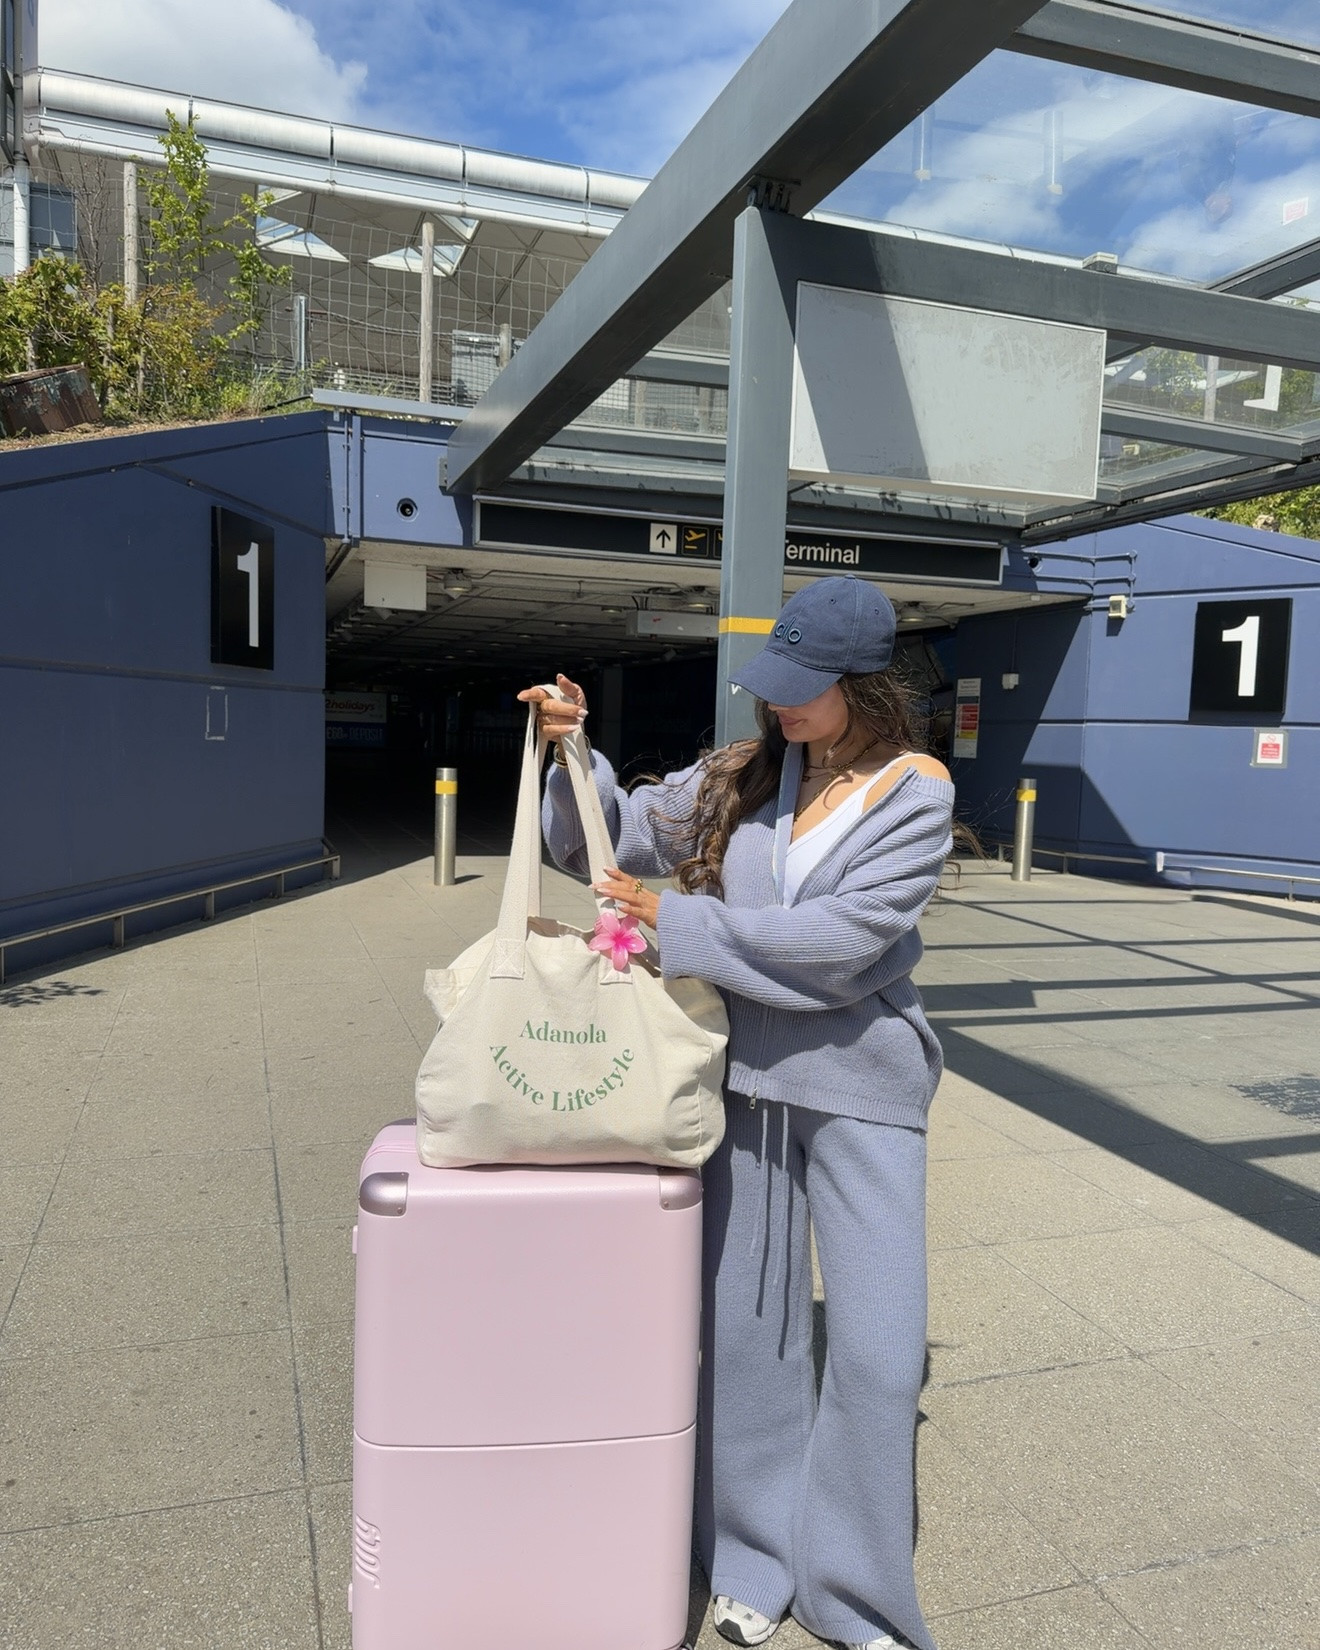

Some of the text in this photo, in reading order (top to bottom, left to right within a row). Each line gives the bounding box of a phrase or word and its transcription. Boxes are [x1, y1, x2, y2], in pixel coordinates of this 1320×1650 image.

[785, 540, 860, 564] erminal
[237, 541, 259, 648] 1
[1222, 616, 1260, 697] 1
[519, 1019, 607, 1045] Adanola
[489, 1045, 635, 1112] Active Lifestyle
